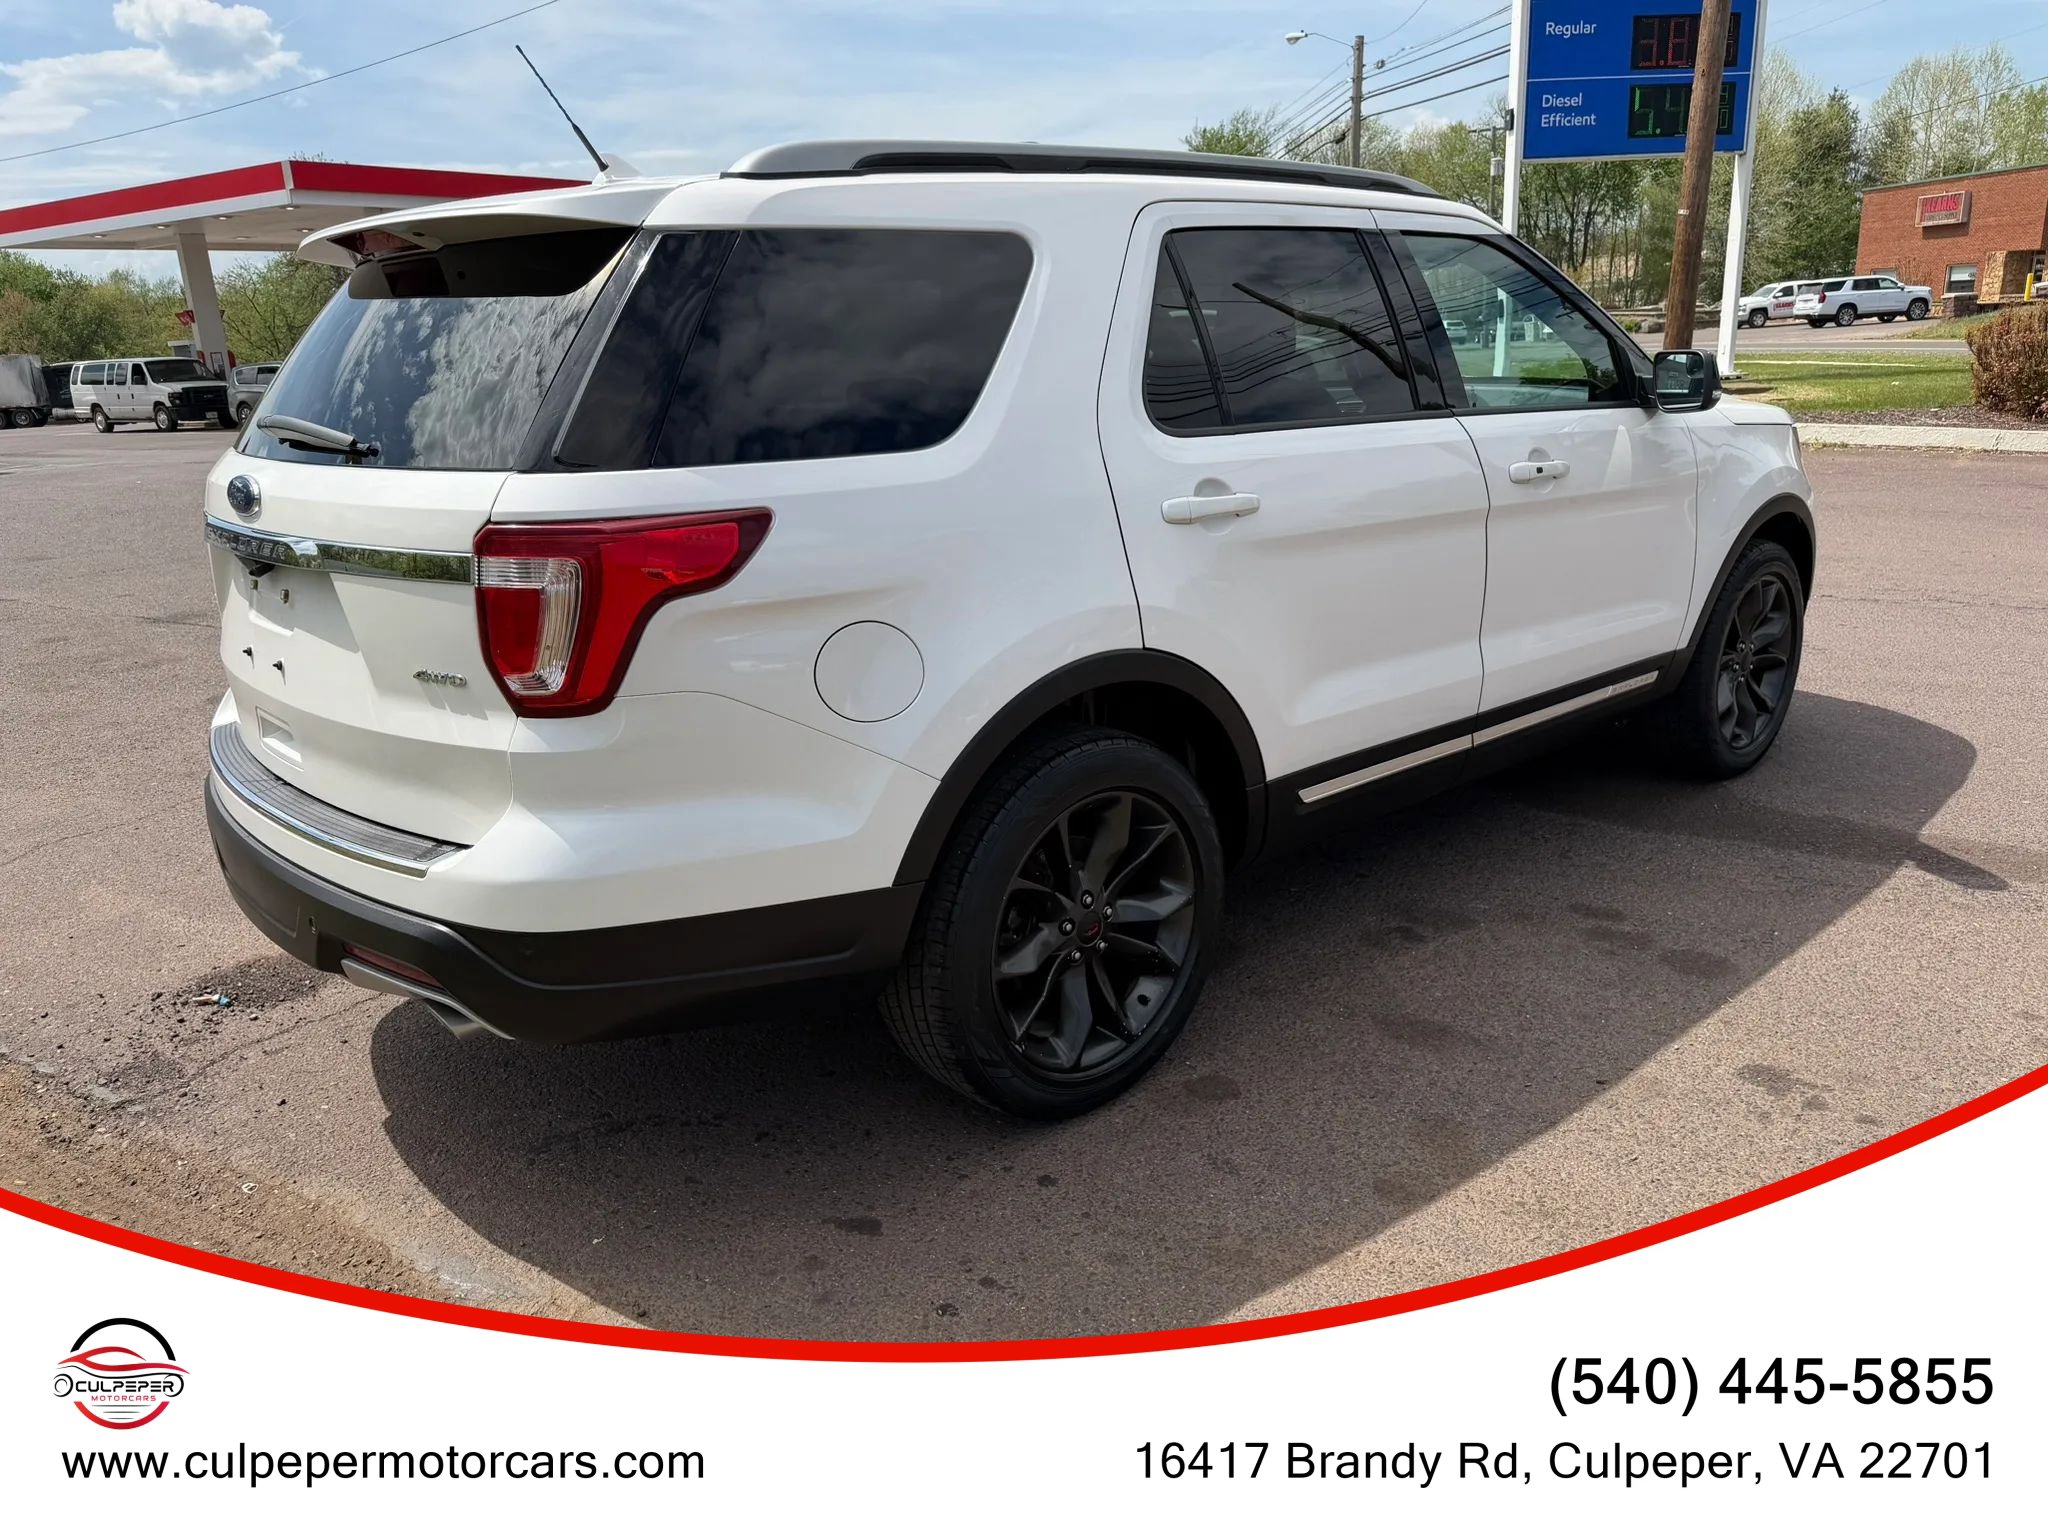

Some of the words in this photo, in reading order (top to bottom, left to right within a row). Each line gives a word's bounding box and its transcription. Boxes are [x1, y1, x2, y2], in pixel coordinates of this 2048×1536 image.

[1545, 20, 1597, 39] Regular
[1542, 92, 1582, 108] Diesel
[1541, 113, 1597, 128] Efficient
[412, 669, 468, 688] 4WD
